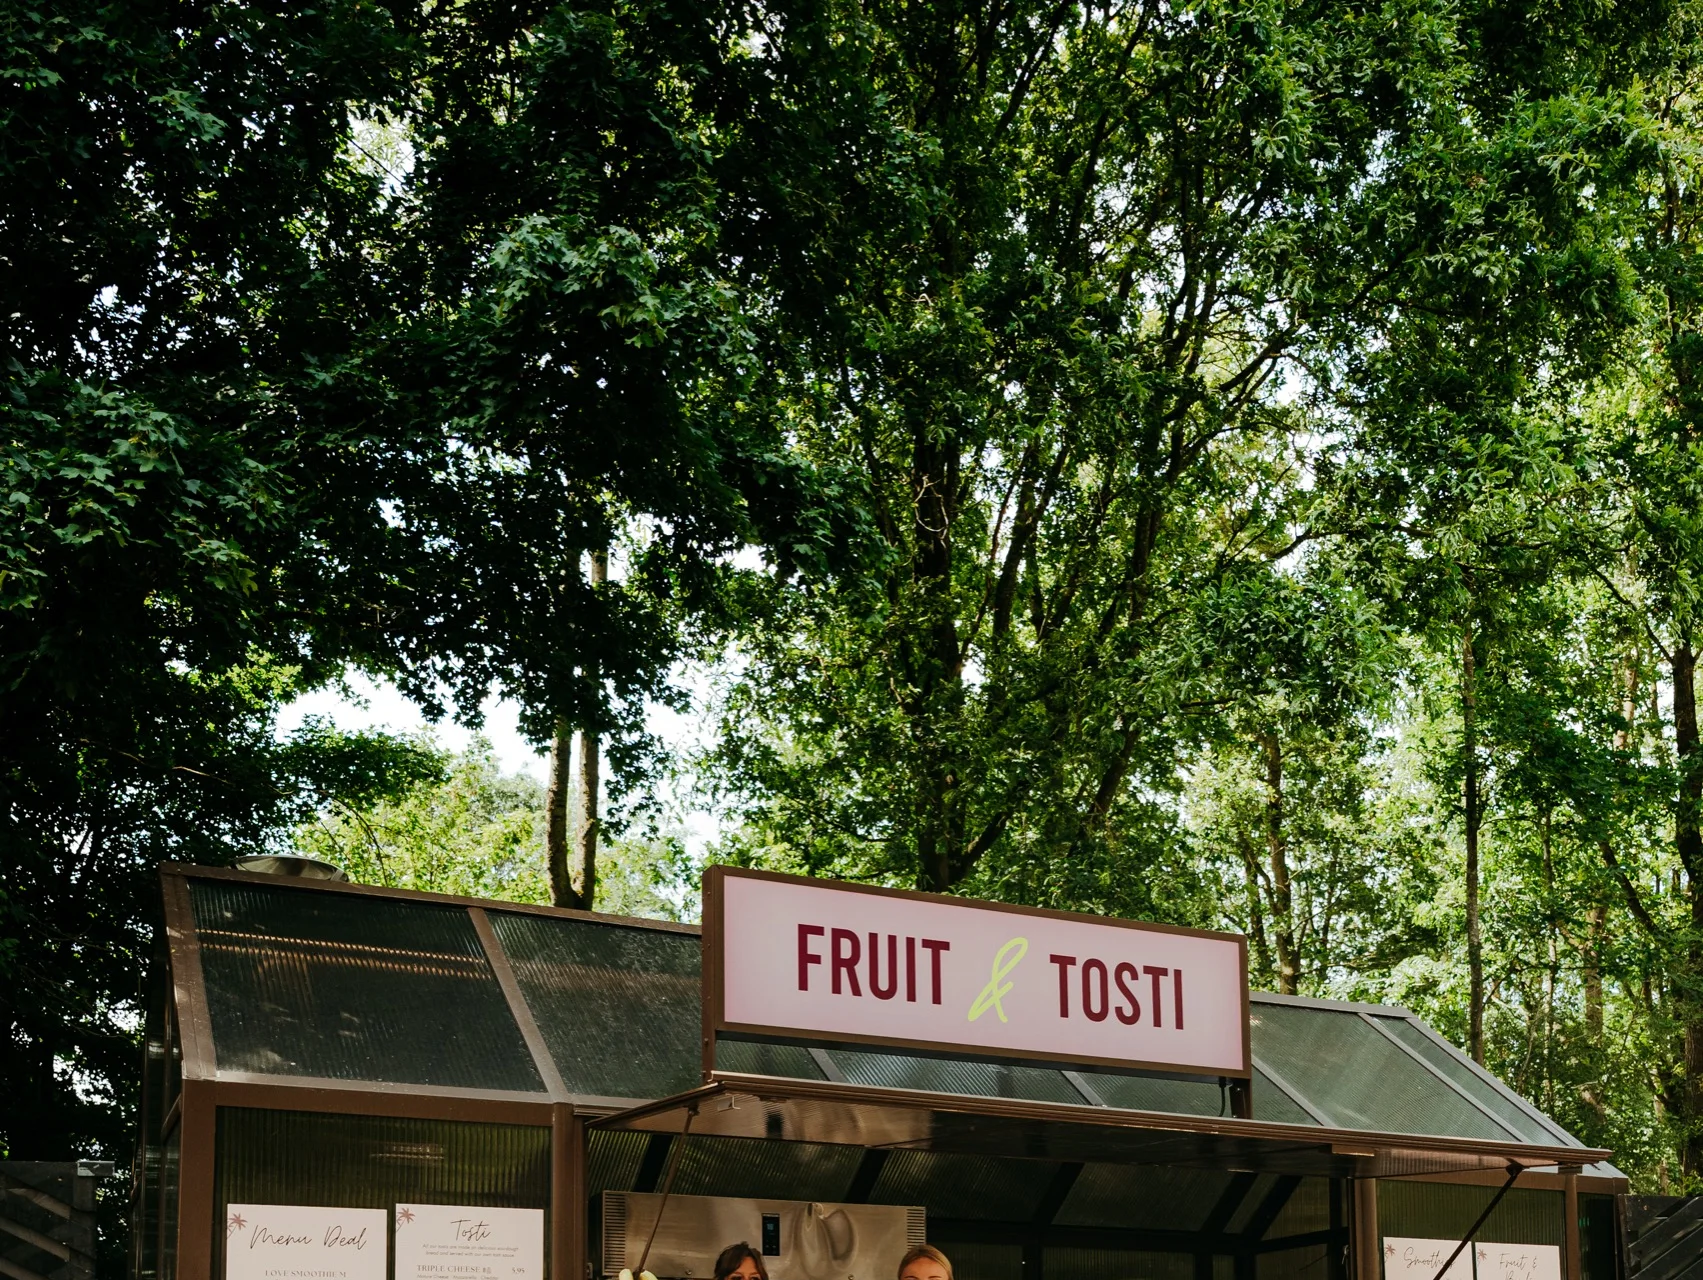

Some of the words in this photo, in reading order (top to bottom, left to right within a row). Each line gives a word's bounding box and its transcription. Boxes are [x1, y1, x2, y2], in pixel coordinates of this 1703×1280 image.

[797, 923, 951, 1006] FRUIT
[967, 936, 1030, 1023] &
[1049, 953, 1185, 1031] TOSTI
[250, 1224, 313, 1251] Menu
[323, 1225, 368, 1251] Deal
[450, 1219, 491, 1242] Tosti
[417, 1265, 446, 1273] TRIPLE
[447, 1265, 481, 1273] CHEESE
[1403, 1246, 1456, 1269] Smoothis
[1499, 1252, 1529, 1270] Fruit
[265, 1269, 289, 1278] LOVE
[291, 1270, 337, 1278] SMOOTHIE
